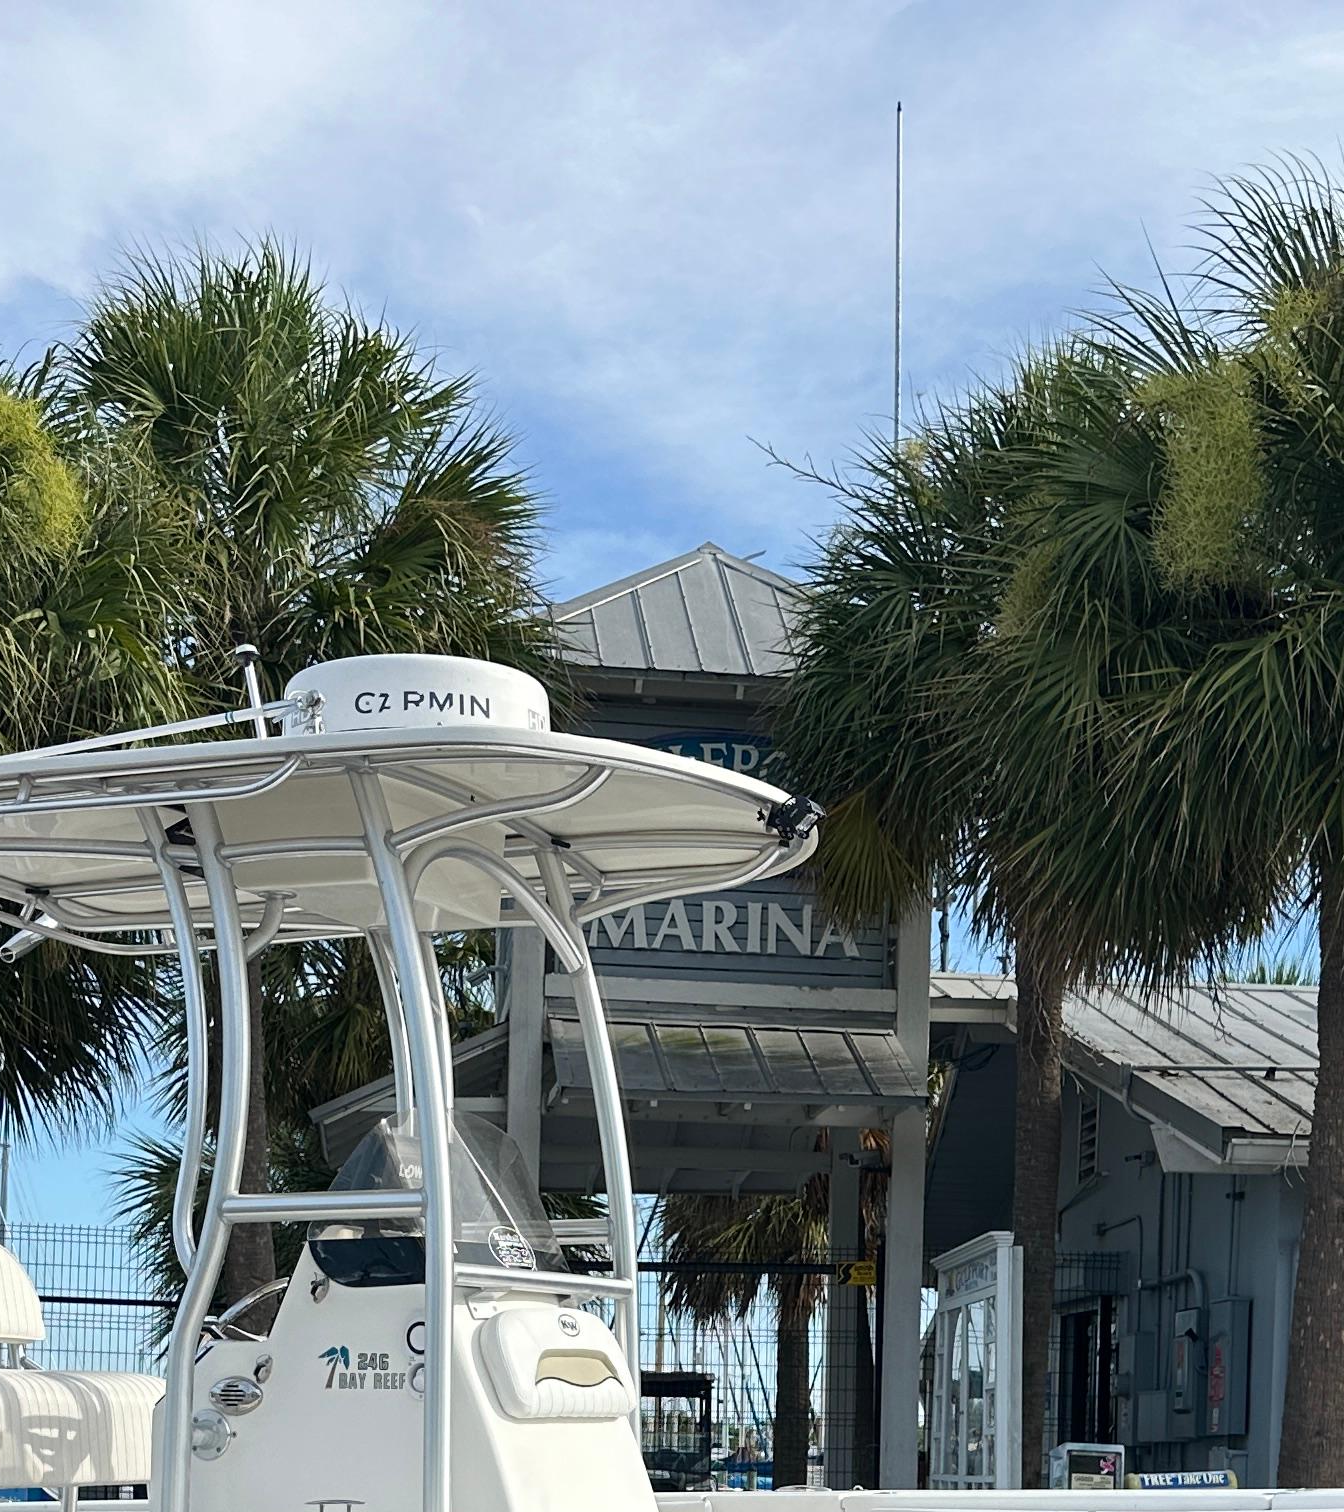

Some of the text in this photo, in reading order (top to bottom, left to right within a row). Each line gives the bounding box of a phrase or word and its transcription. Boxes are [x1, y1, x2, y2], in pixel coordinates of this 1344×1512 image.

[588, 898, 860, 957] MARINA
[357, 1352, 390, 1371] 246
[338, 1372, 406, 1390] BAY REEF
[1143, 1472, 1225, 1486] FREE Take One
